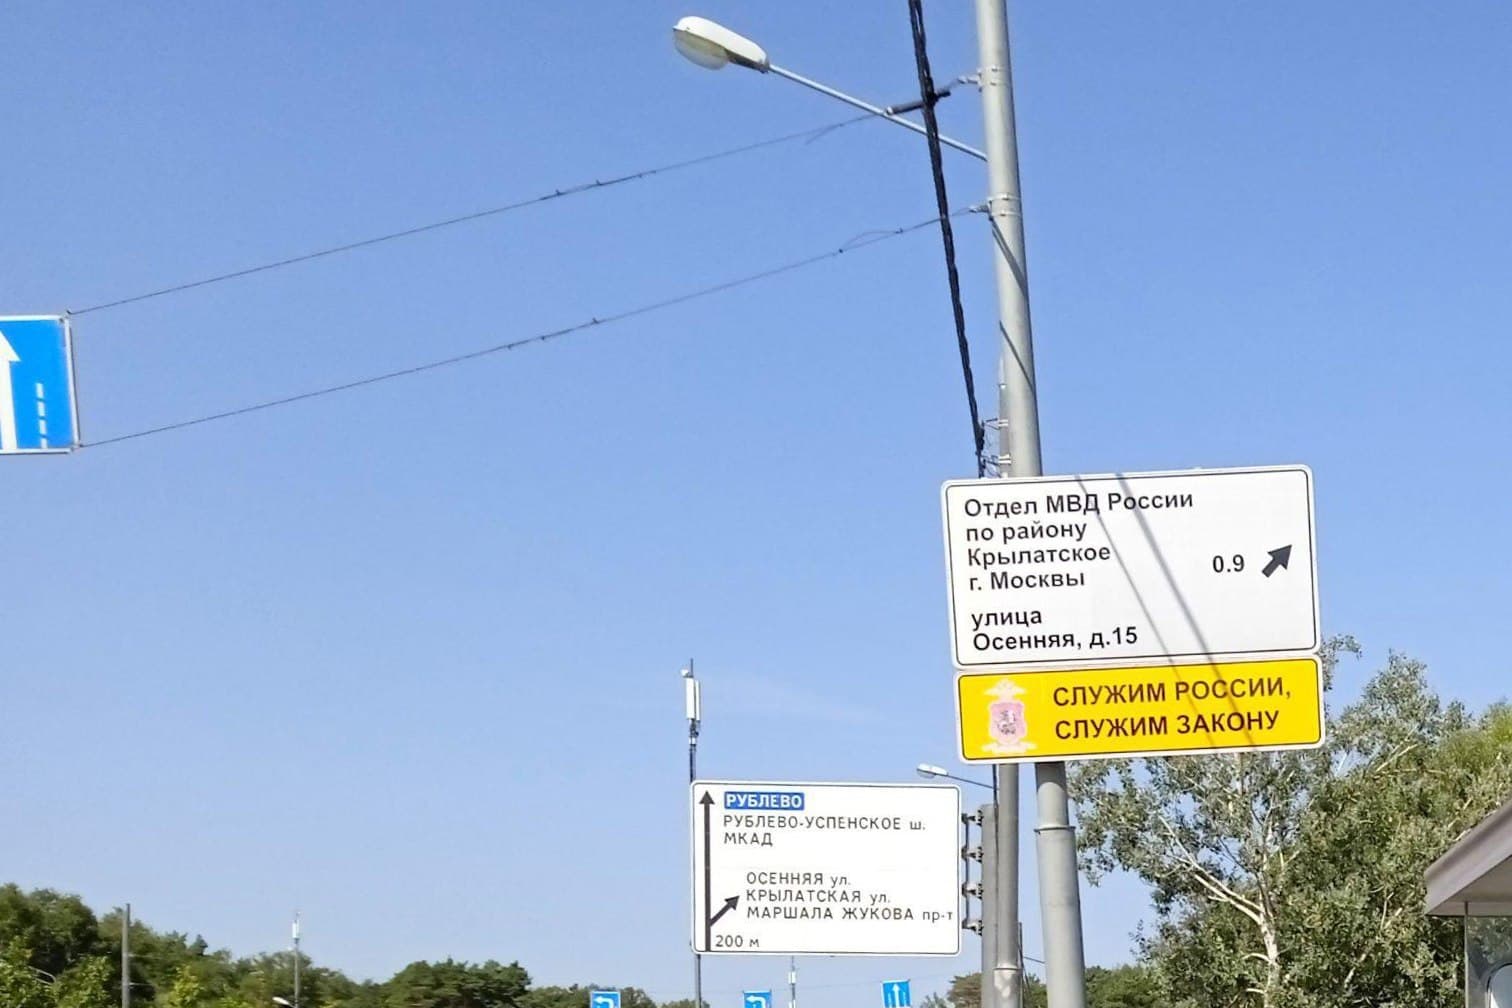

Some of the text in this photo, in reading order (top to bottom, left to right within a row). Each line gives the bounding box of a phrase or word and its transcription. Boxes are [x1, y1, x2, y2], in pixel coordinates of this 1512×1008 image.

[964, 491, 1193, 517] Отдел МВД России
[966, 520, 1087, 544] по району
[968, 545, 1111, 569] Крылатское
[1212, 554, 1245, 573] 0.9
[969, 571, 1085, 591] г. Москвы
[972, 609, 1043, 631] улица
[973, 627, 1138, 651] Осенняя, д.15
[1053, 678, 1291, 707] СЛУЖИМ РОССИИ,
[1055, 709, 1280, 740] СЛУЖИМ ЗАКОНУ
[725, 794, 803, 809] РУБЛЕВО
[723, 815, 926, 831] РУБЛЕВО-УСПЕНСКОЕ ш.
[723, 832, 774, 848] МКАД
[746, 872, 851, 888] ОСЕННЯЯ ул.
[746, 889, 891, 905] КРЫЛАТСКАЯ ул.
[747, 907, 953, 923] МАРШАЛА ЖУКОВА пр-т
[715, 935, 760, 948] 200 м
